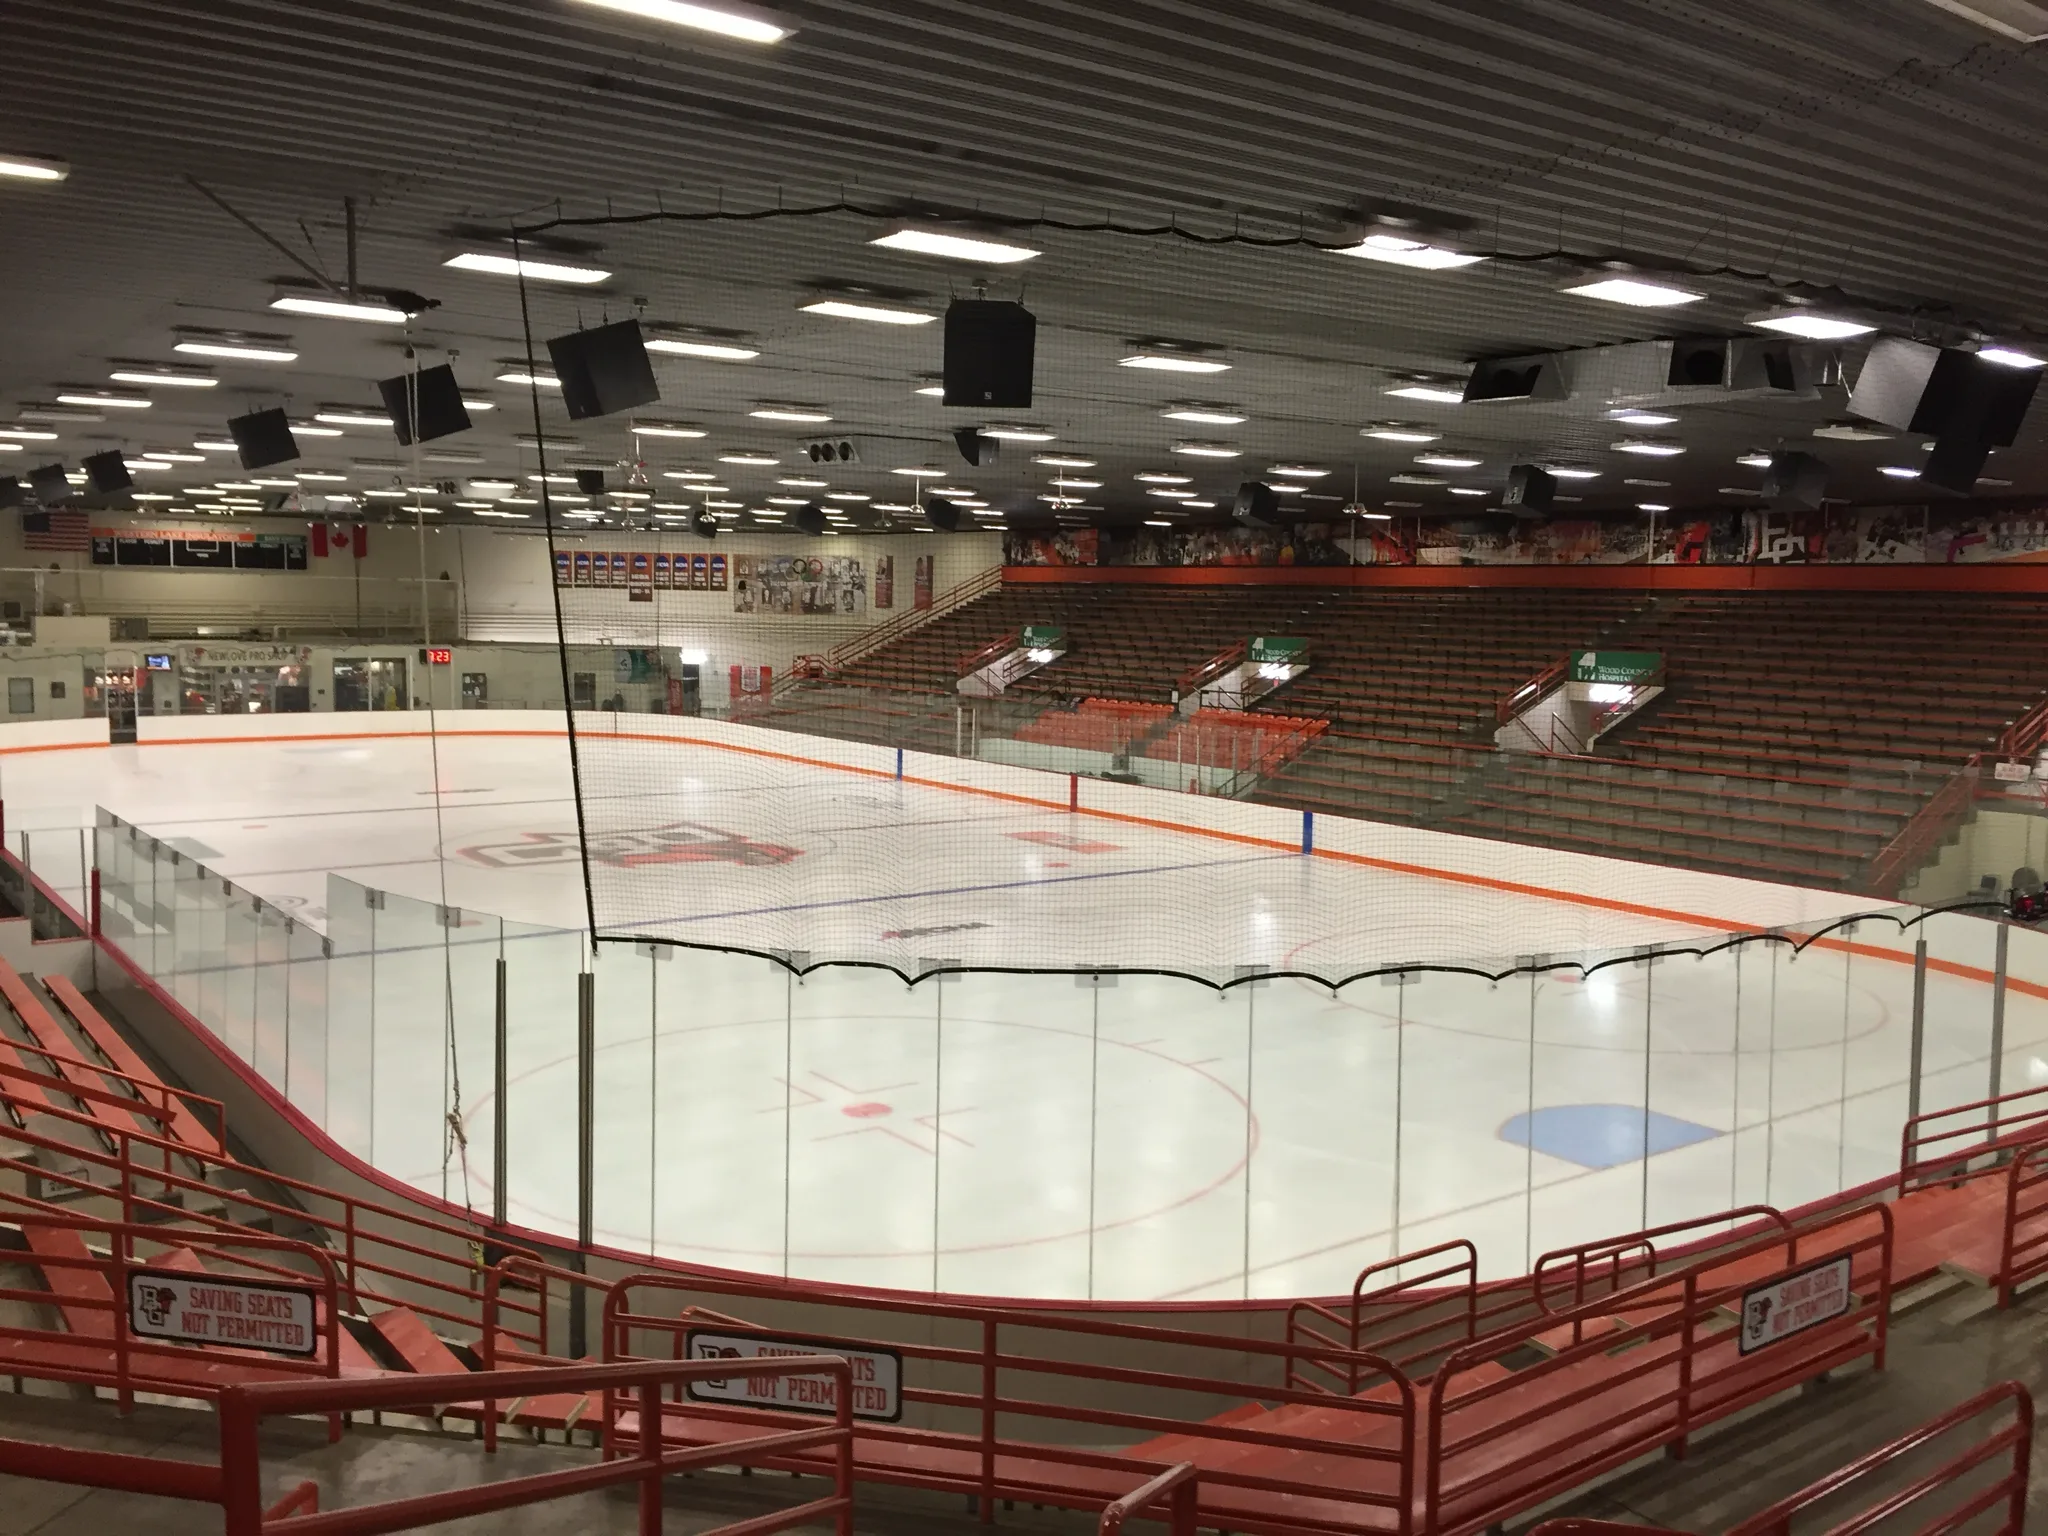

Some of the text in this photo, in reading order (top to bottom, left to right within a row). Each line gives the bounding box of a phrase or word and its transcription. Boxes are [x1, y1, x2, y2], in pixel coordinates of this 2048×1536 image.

[1597, 665, 1620, 675] WOOD
[1598, 673, 1631, 682] HOSPITAL
[189, 1286, 293, 1319] SAVING SEATS
[181, 1311, 304, 1347] NOT PERMITTED
[747, 1375, 887, 1412] NOT PERMTED
